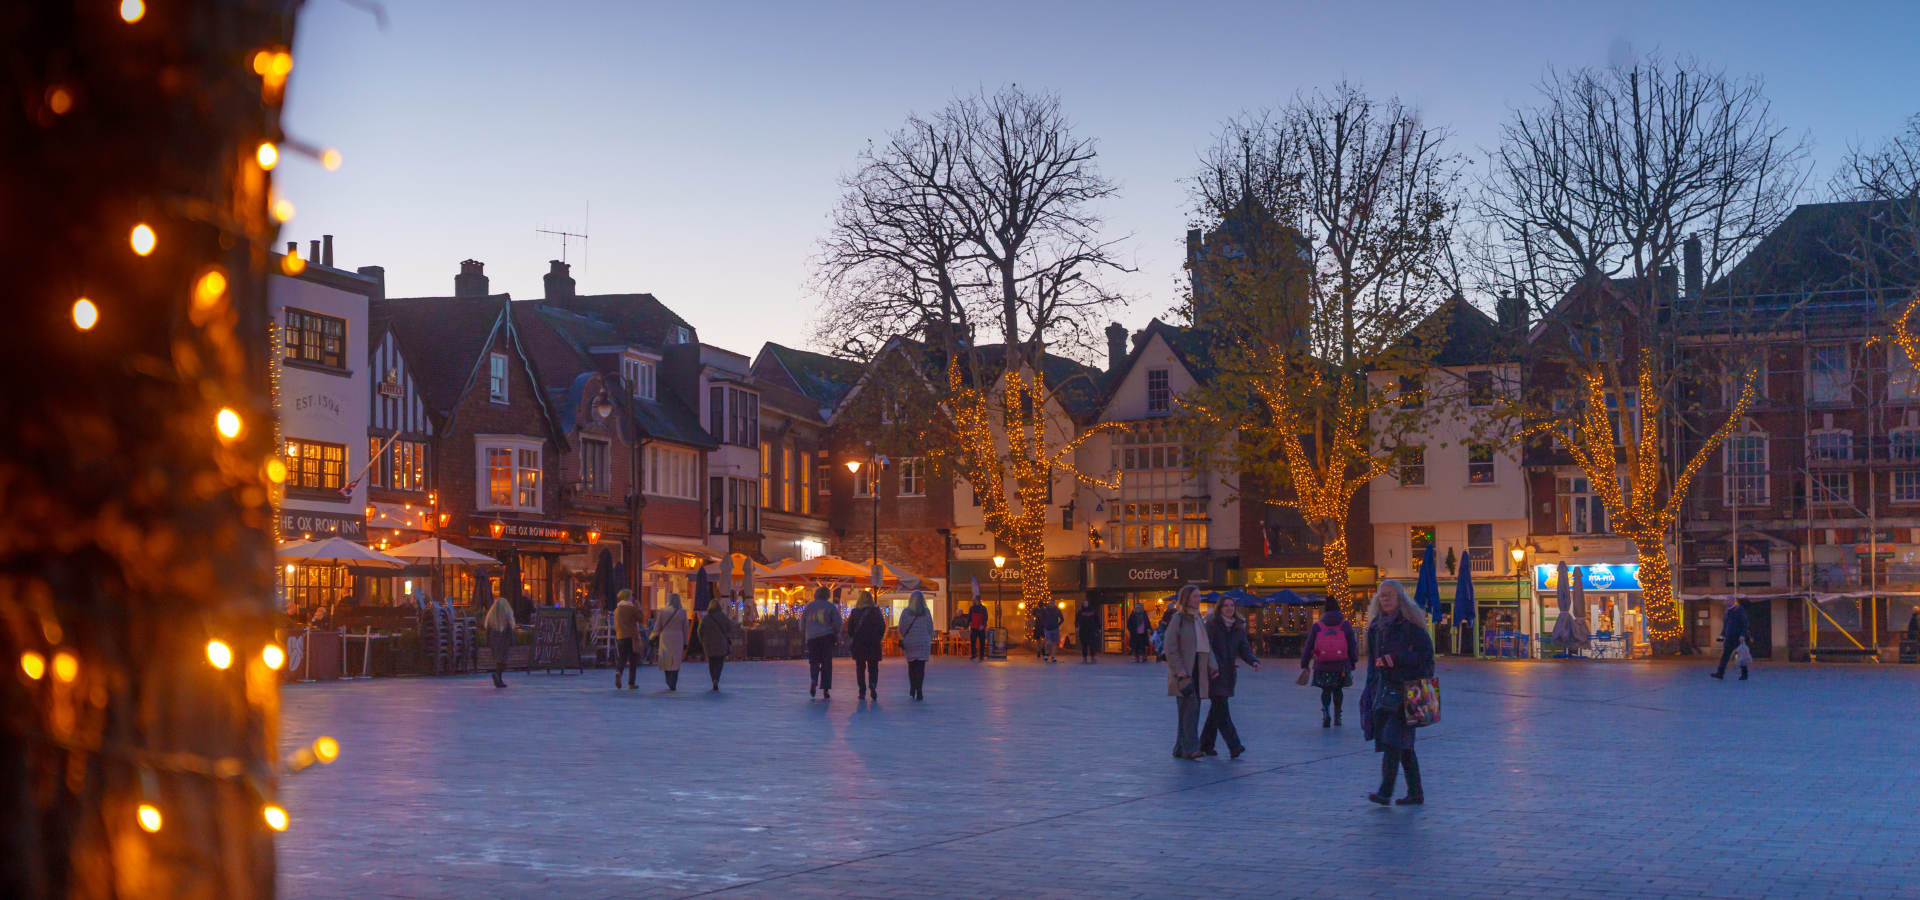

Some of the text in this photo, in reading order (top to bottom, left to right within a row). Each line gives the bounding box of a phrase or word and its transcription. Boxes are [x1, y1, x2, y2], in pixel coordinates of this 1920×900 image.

[318, 394, 339, 416] 1594
[297, 516, 312, 531] OX
[315, 518, 339, 532] ROW
[342, 520, 360, 534] INN
[505, 525, 557, 538] THE OX ROW INN
